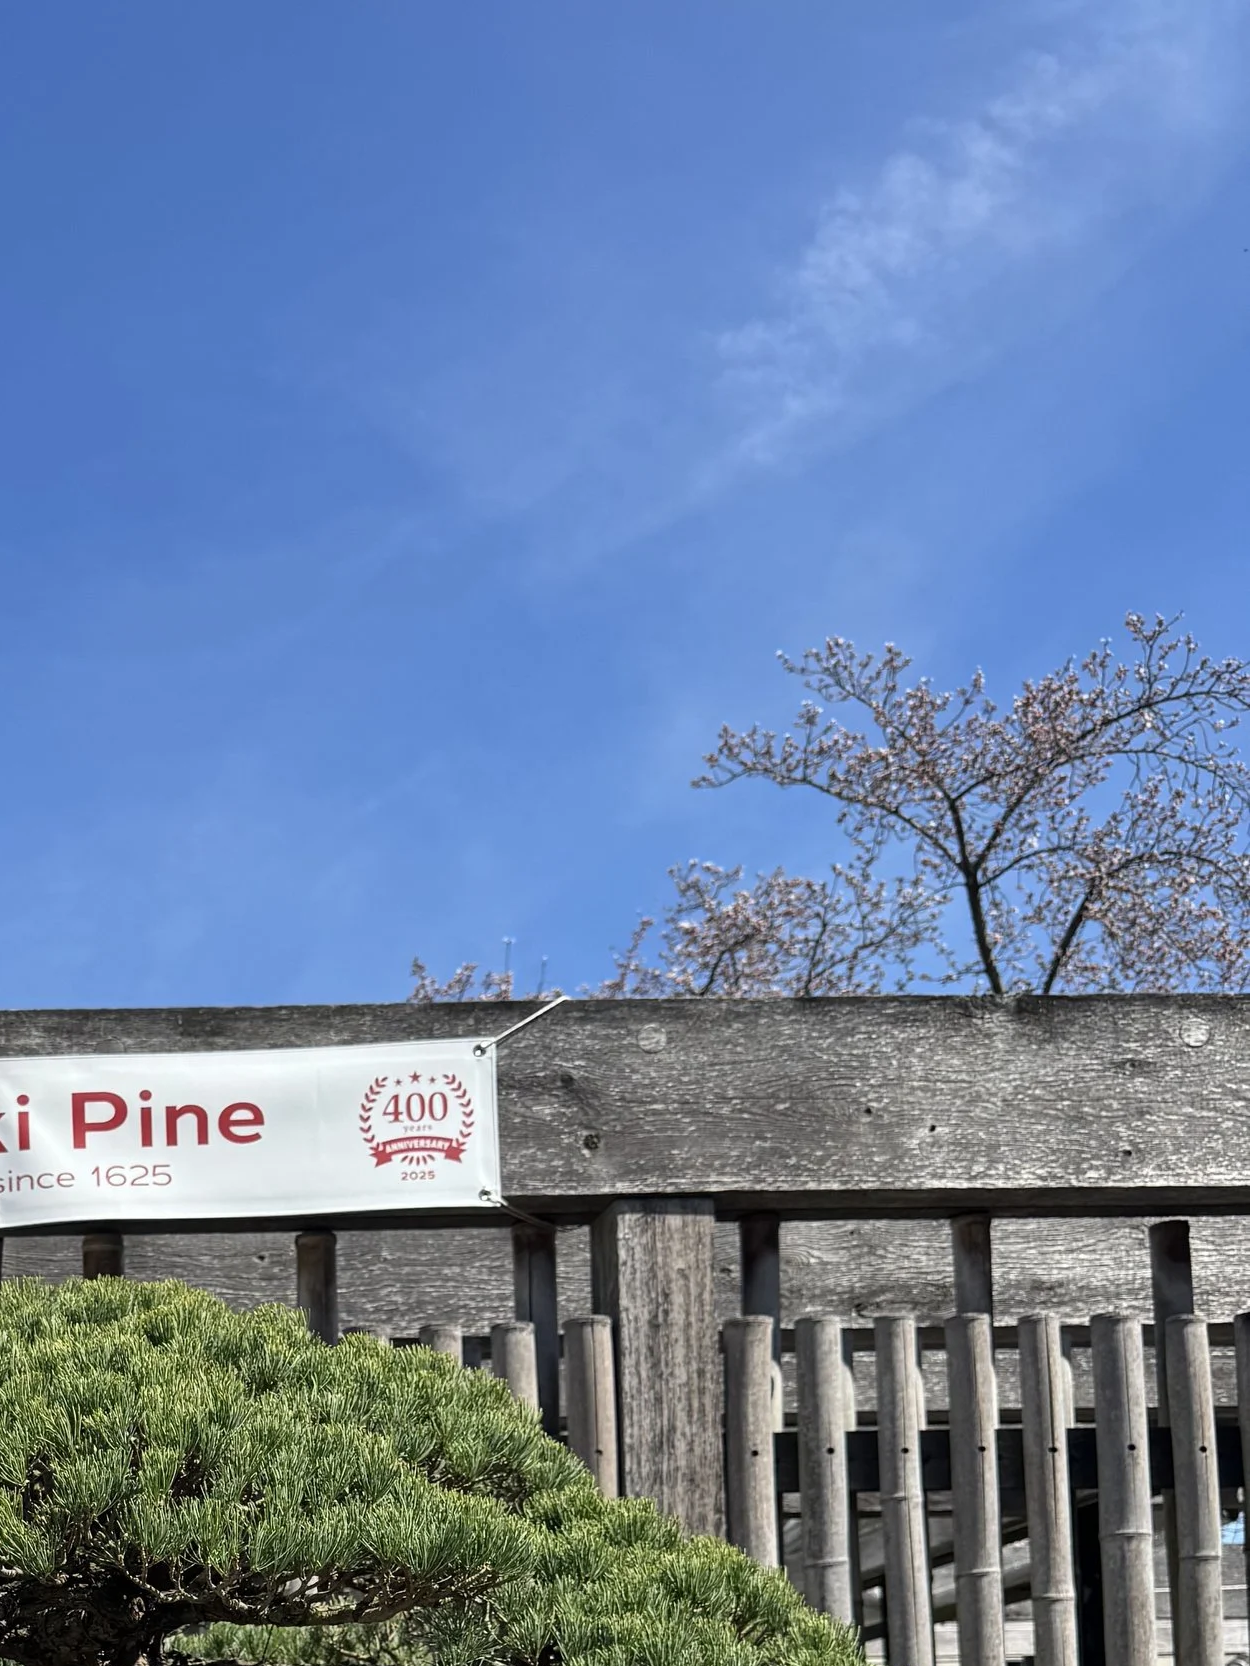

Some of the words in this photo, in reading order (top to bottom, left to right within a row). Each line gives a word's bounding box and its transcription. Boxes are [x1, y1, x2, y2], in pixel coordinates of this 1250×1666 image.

[382, 1092, 448, 1123] 400
[71, 1089, 265, 1150] Pine
[403, 1124, 433, 1134] years
[388, 1138, 448, 1151] ANNIVERSARY
[92, 1164, 173, 1188] 1625
[401, 1171, 436, 1181] 2025
